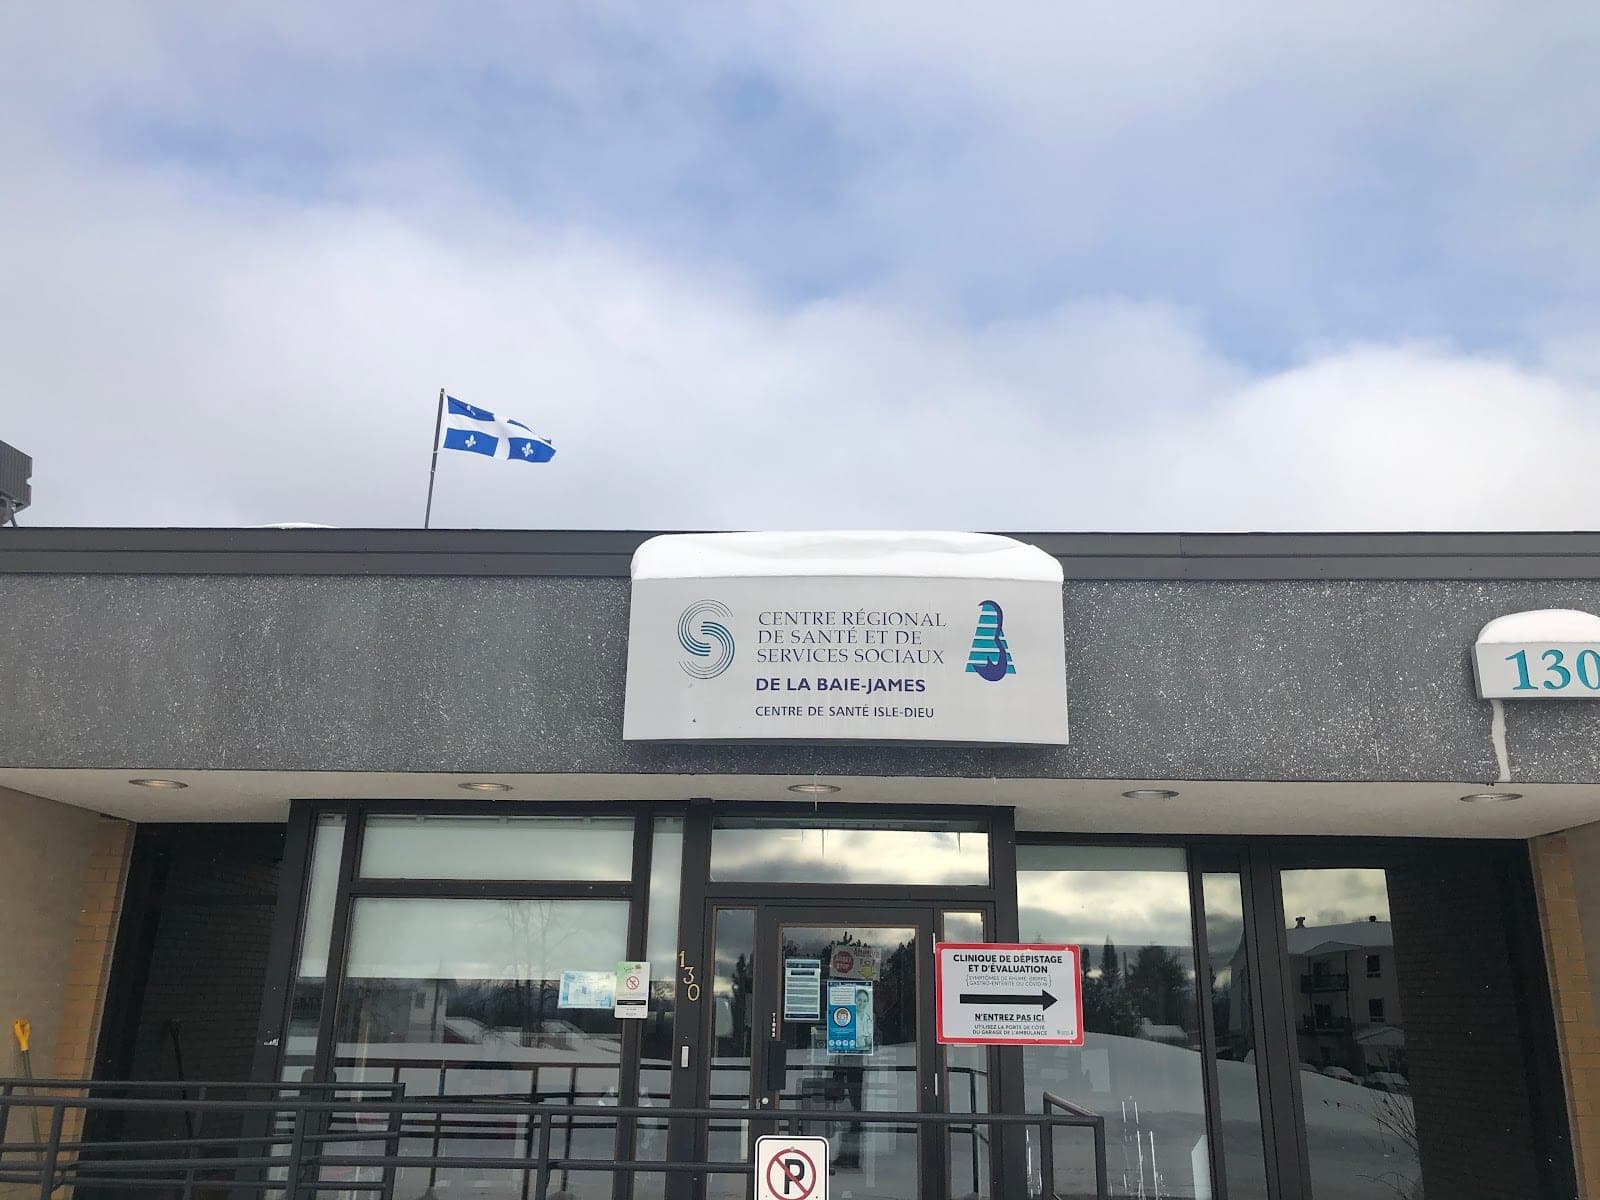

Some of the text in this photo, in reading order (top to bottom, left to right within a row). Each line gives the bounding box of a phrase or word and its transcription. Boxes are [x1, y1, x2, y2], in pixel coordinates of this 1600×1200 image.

[758, 608, 947, 627] CENTRE RÉGIONAL
[758, 627, 922, 645] DE SANTÉ ET DE
[757, 648, 945, 664] SERVICES SOCIAUX
[1505, 649, 1600, 690] 130
[756, 678, 926, 694] DE LA BAIE-JAMES
[755, 704, 934, 718] CENTRE DE SANTÉ ISLE-DIEU
[953, 953, 1063, 964] CLINIQUE DE DÉPISTAGE
[968, 963, 1048, 974] ET D'ÉVALUATION
[975, 1013, 1014, 1021] N'ENTREZ
[1033, 1014, 1045, 1022] ICI
[784, 1159, 805, 1194] P
